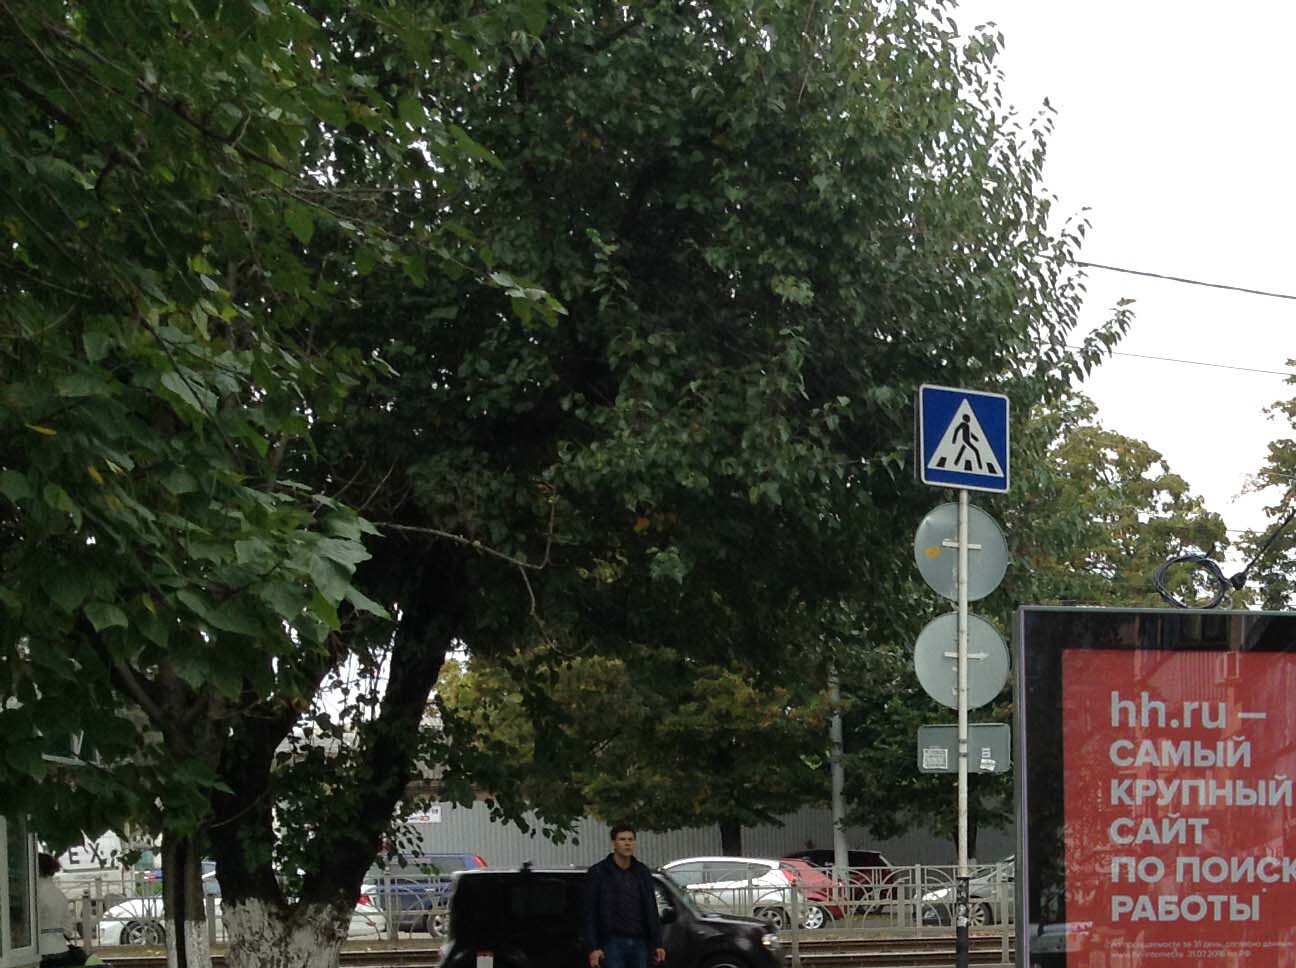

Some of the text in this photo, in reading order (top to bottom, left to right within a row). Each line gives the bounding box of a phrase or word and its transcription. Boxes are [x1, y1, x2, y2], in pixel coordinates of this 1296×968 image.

[1110, 691, 1226, 728] hh.ru
[1109, 736, 1251, 768] САМЫЙ
[1110, 774, 1293, 806] КРУПНЫЙ
[1109, 813, 1209, 844] САЙТ
[1111, 856, 1165, 883] ПО
[1111, 895, 1259, 922] РАБОТЫ
